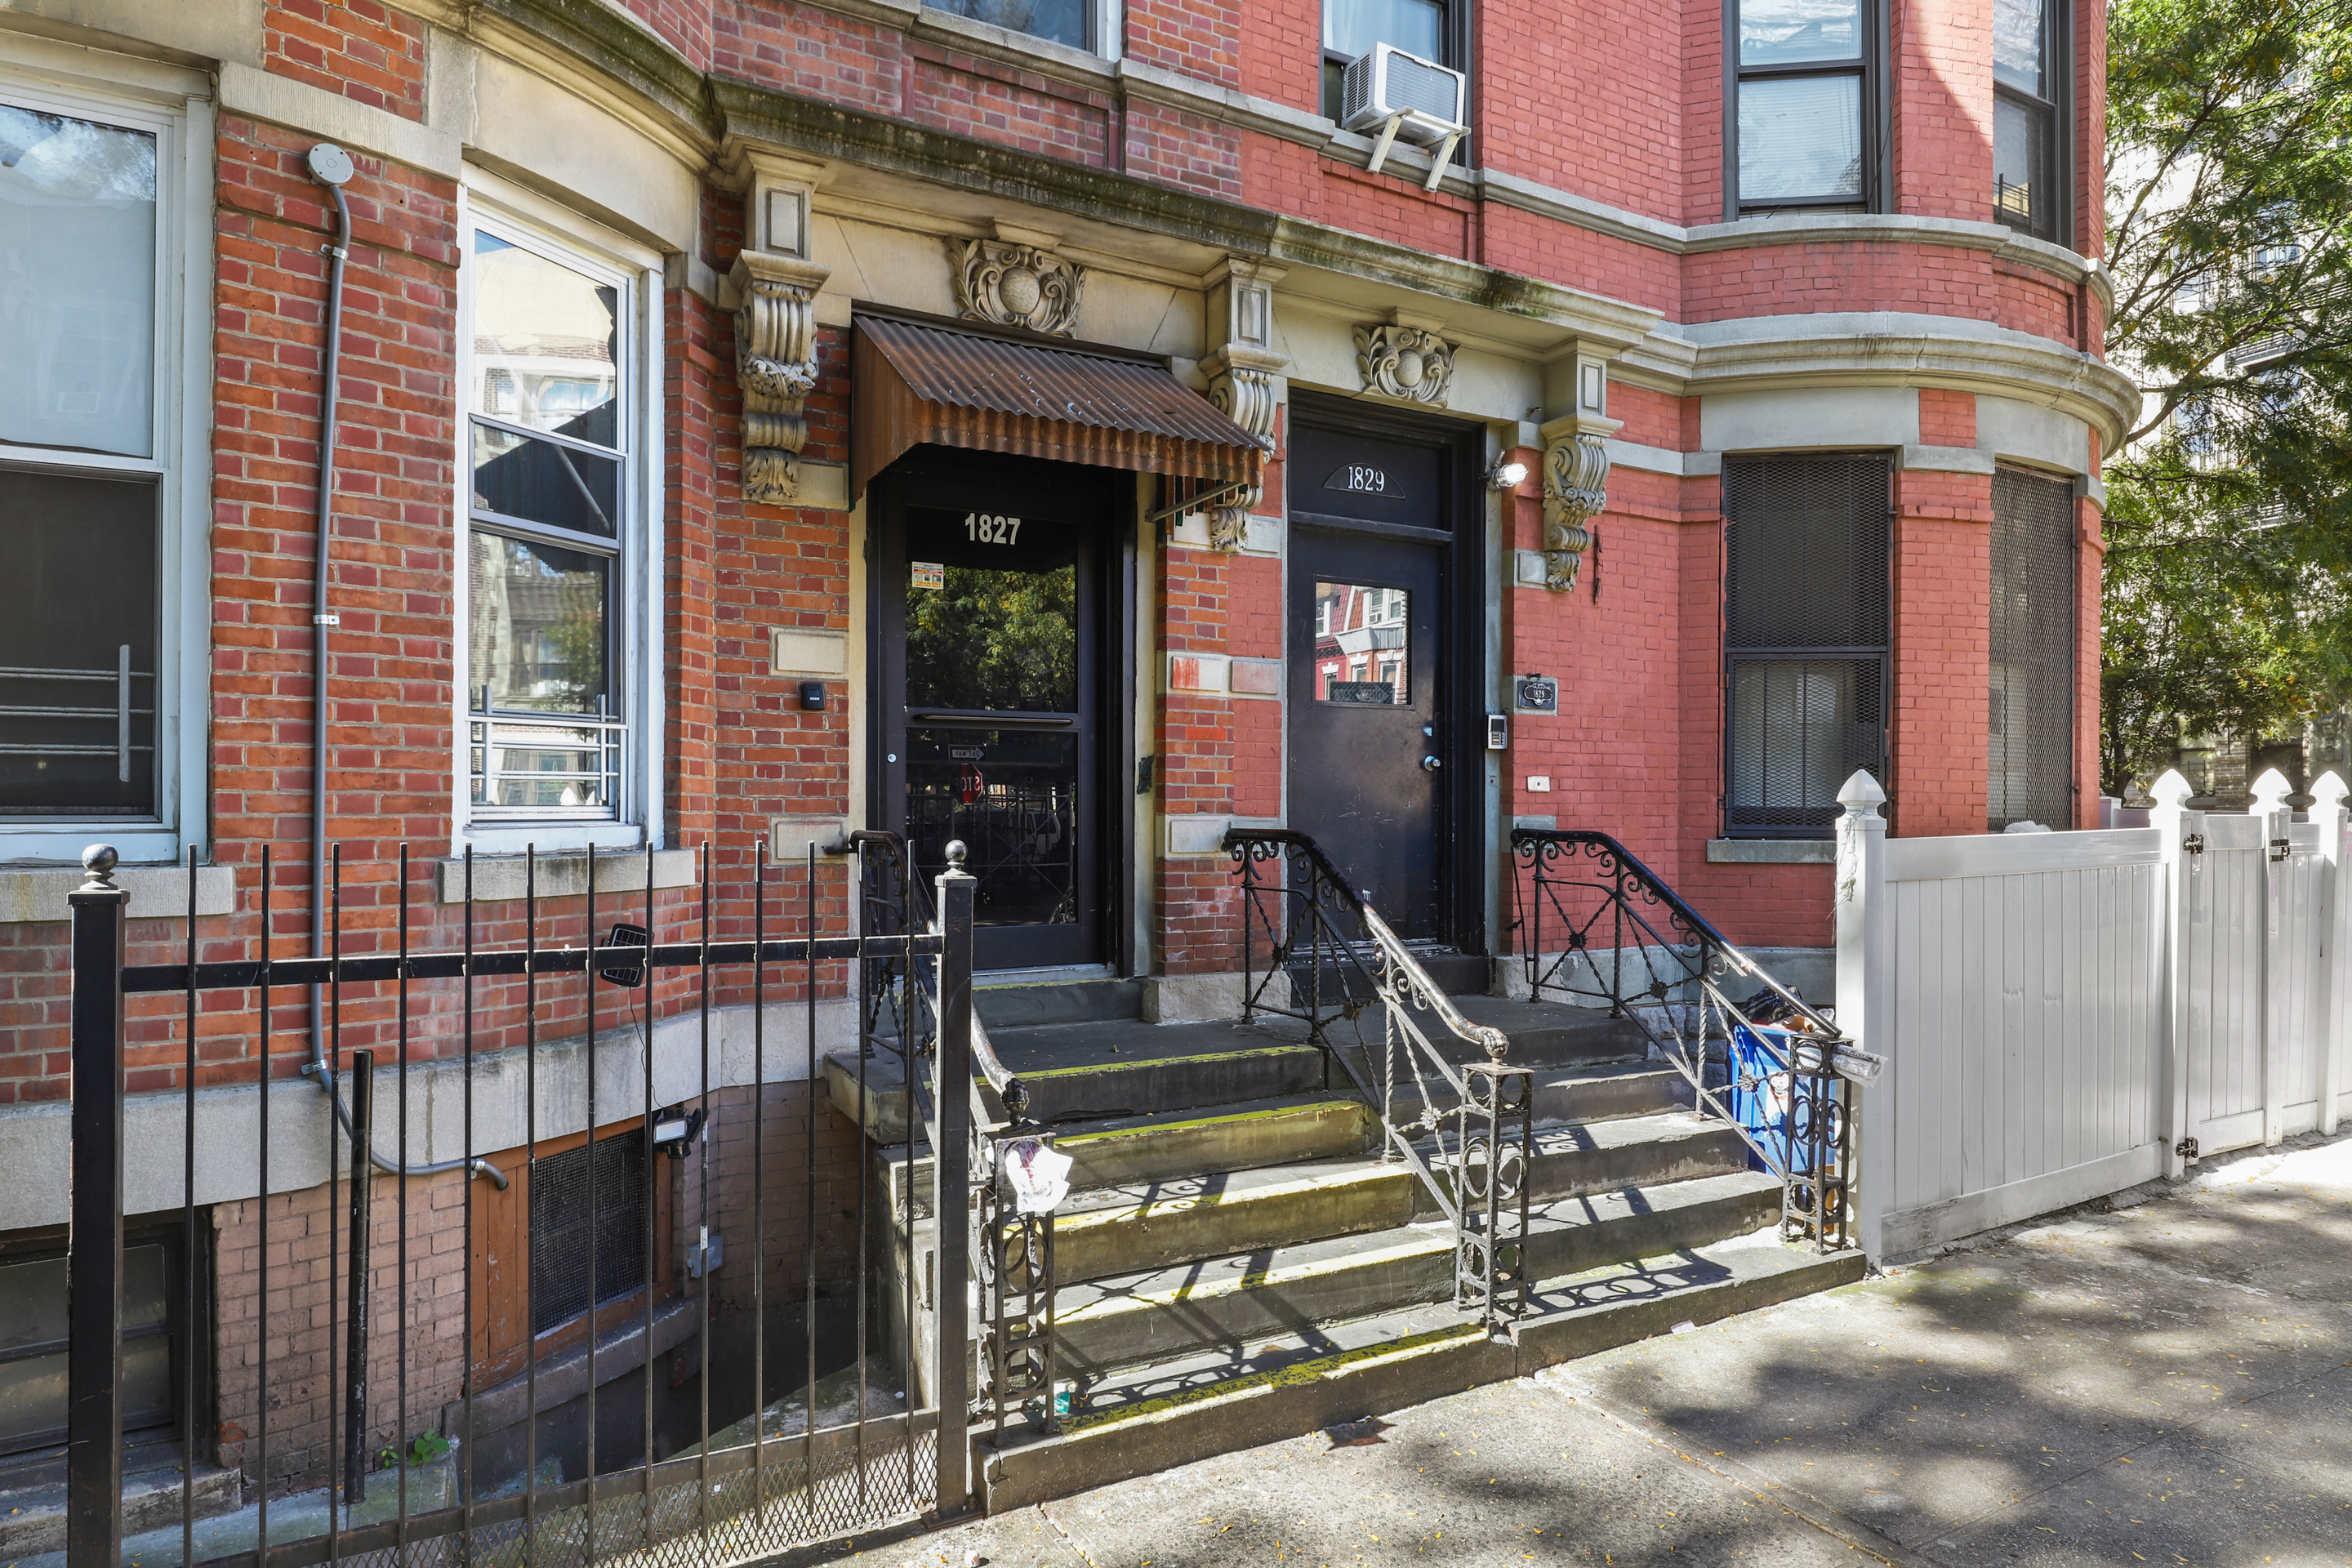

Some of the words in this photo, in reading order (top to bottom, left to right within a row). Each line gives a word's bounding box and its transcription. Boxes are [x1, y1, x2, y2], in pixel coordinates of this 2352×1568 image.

[1348, 466, 1385, 492] 1829
[964, 513, 1021, 545] 1827
[1533, 689, 1545, 698] 1829
